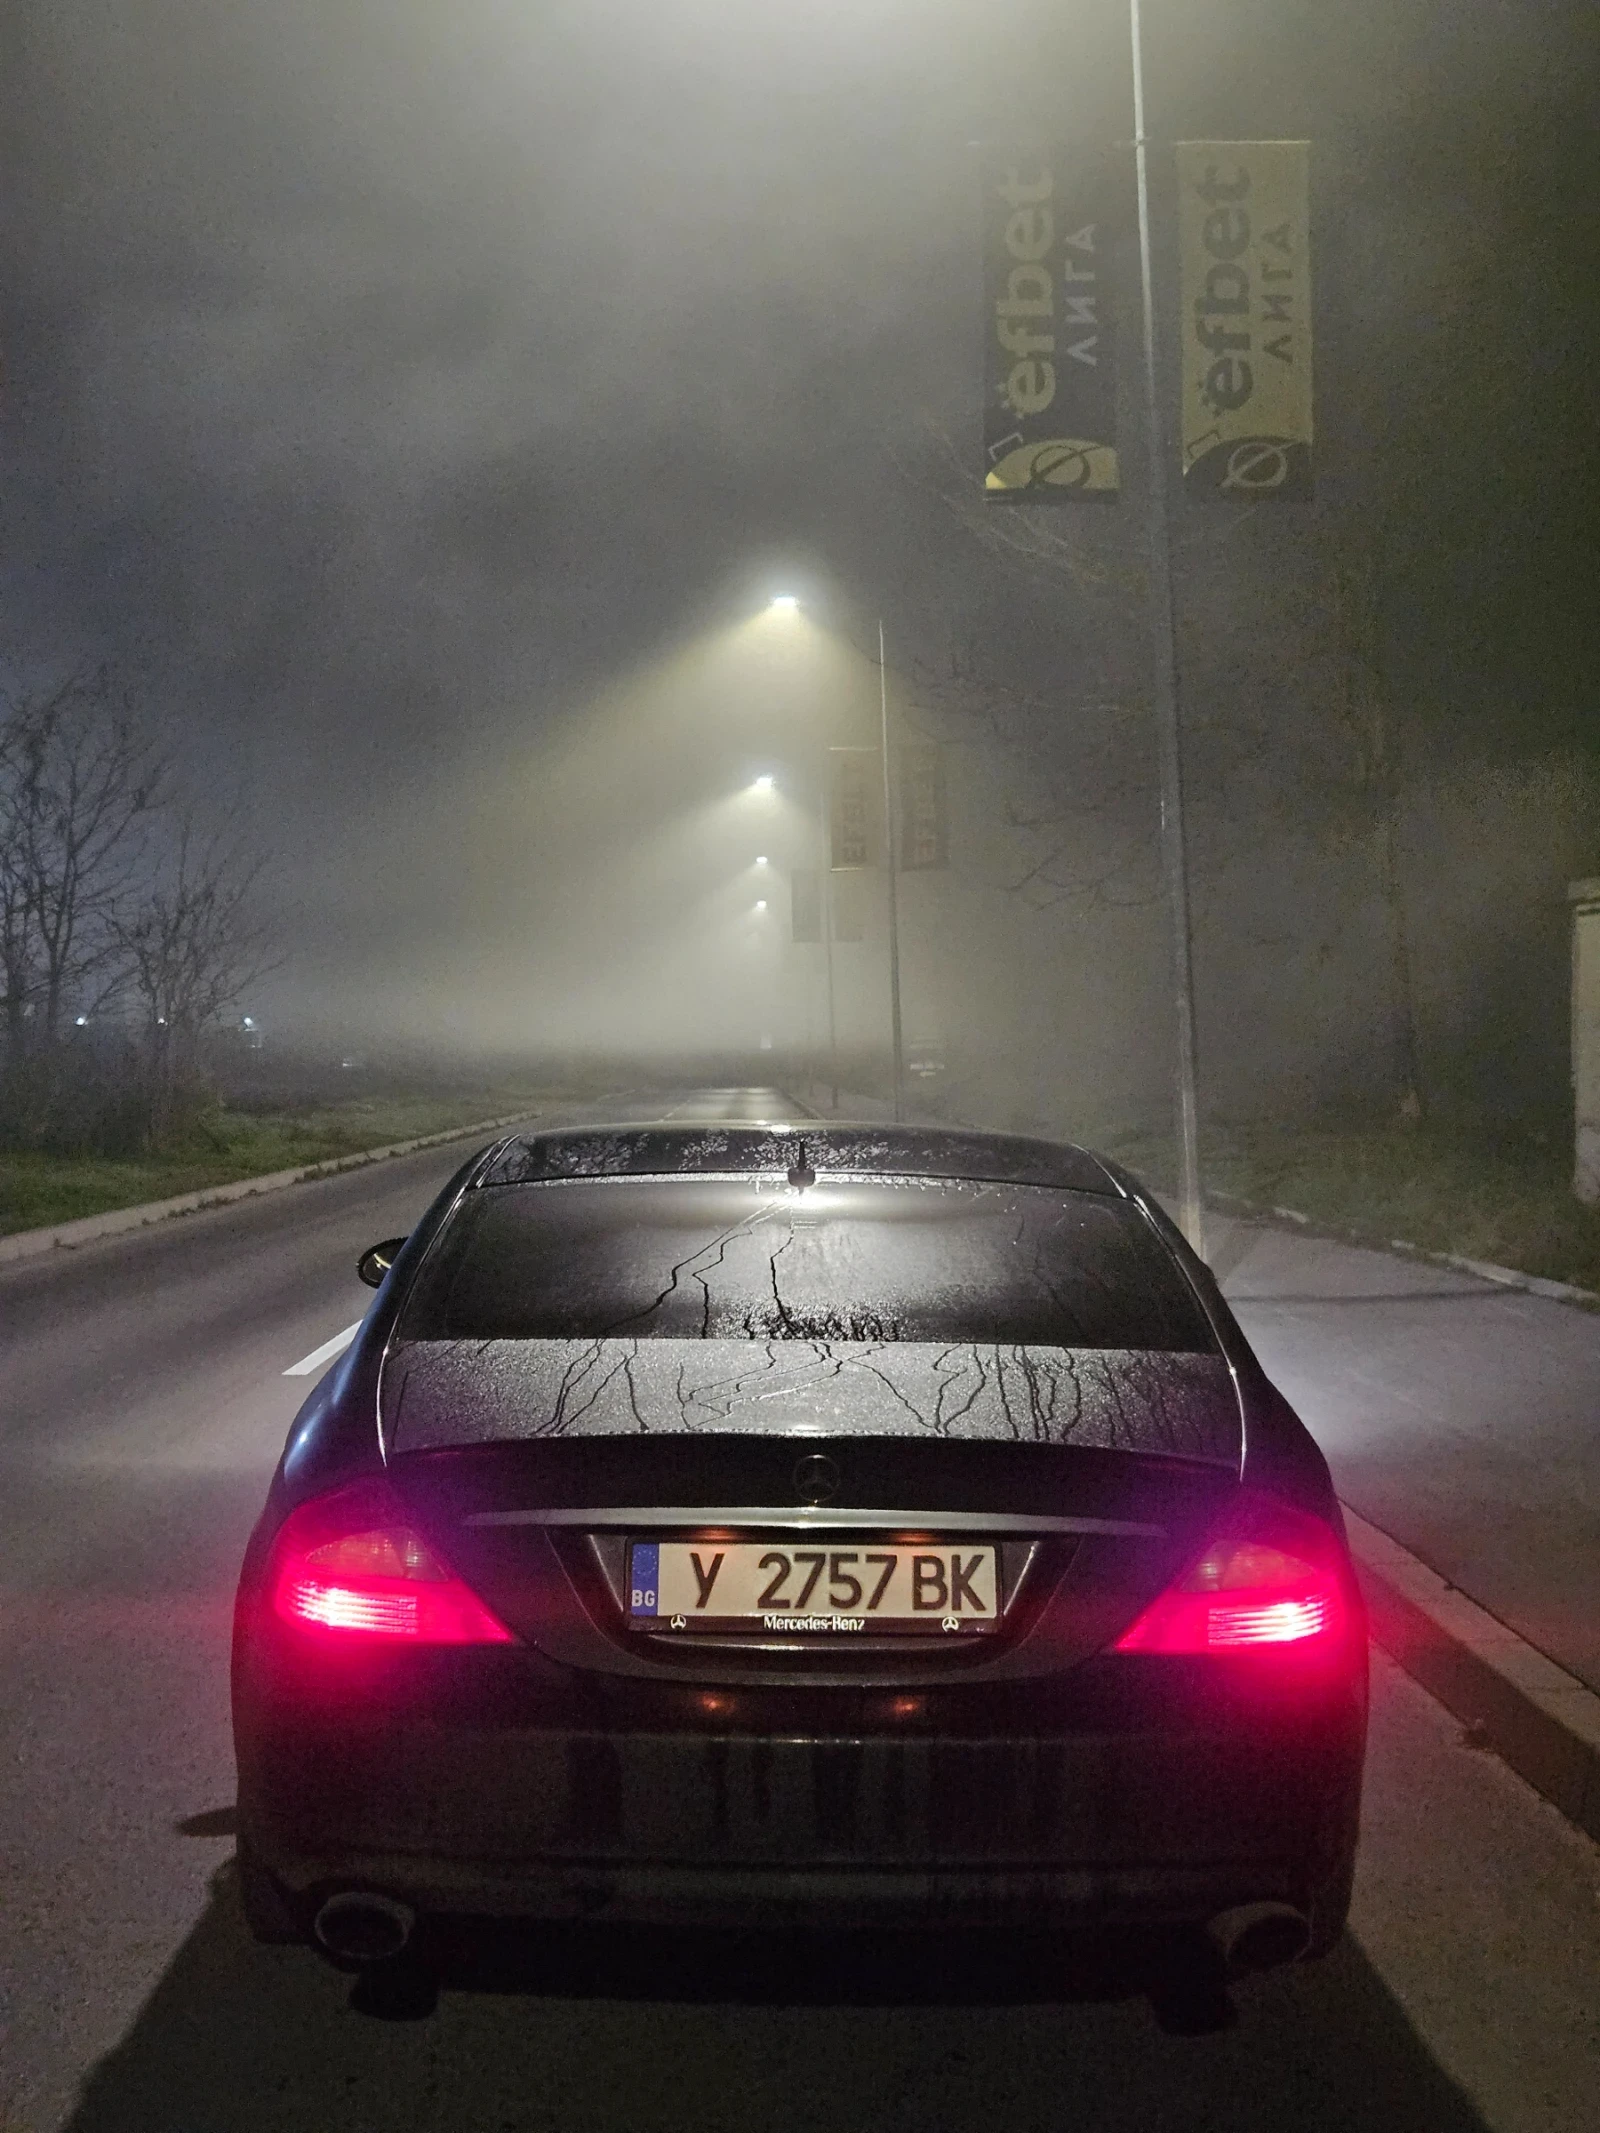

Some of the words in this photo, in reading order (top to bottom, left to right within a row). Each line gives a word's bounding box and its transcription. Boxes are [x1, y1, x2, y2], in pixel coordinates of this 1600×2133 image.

[996, 164, 1056, 416] efbet
[1194, 163, 1254, 413] efbet
[632, 1589, 655, 1607] BG
[757, 1552, 897, 1610] 2757
[912, 1554, 987, 1612] BK
